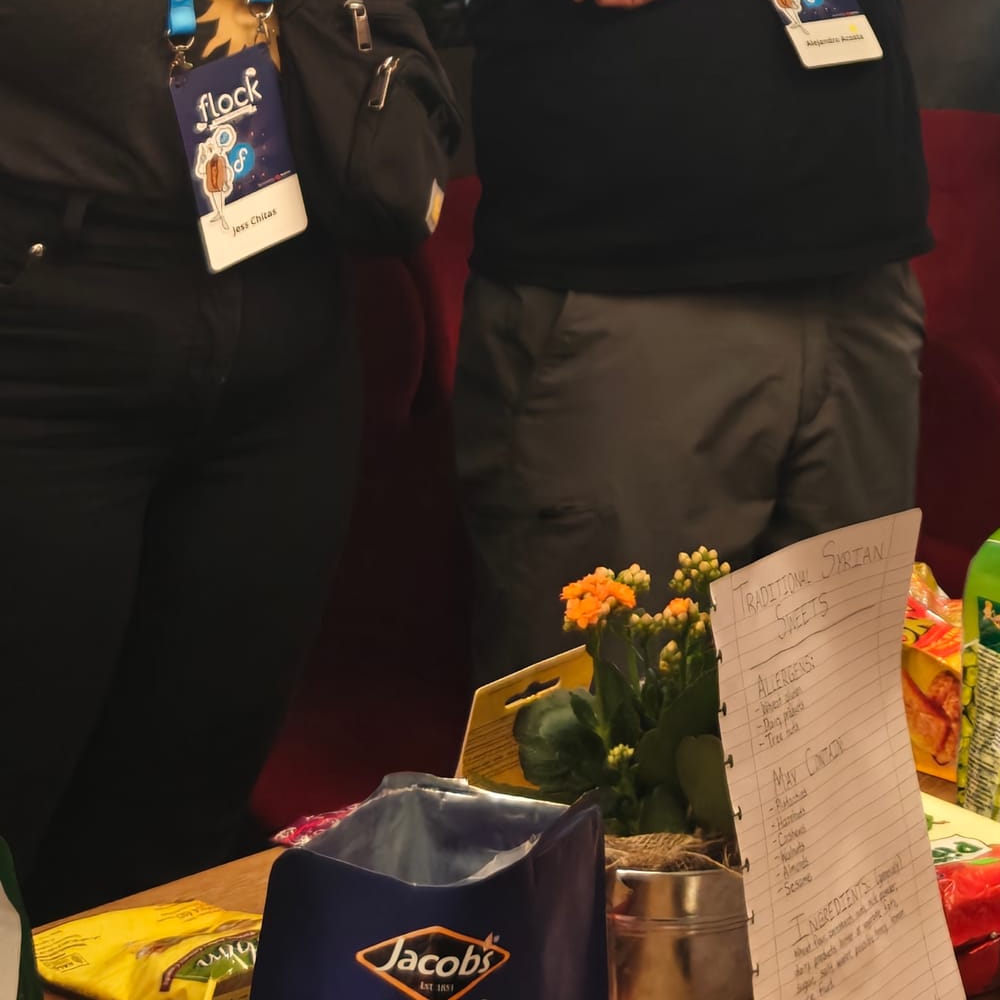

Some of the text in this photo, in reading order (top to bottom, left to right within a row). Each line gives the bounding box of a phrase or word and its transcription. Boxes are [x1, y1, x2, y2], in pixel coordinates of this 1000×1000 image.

[196, 67, 263, 132] flock
[232, 220, 251, 236] Jess
[776, 592, 829, 640] SWEETS
[375, 937, 494, 978] Jacobs
